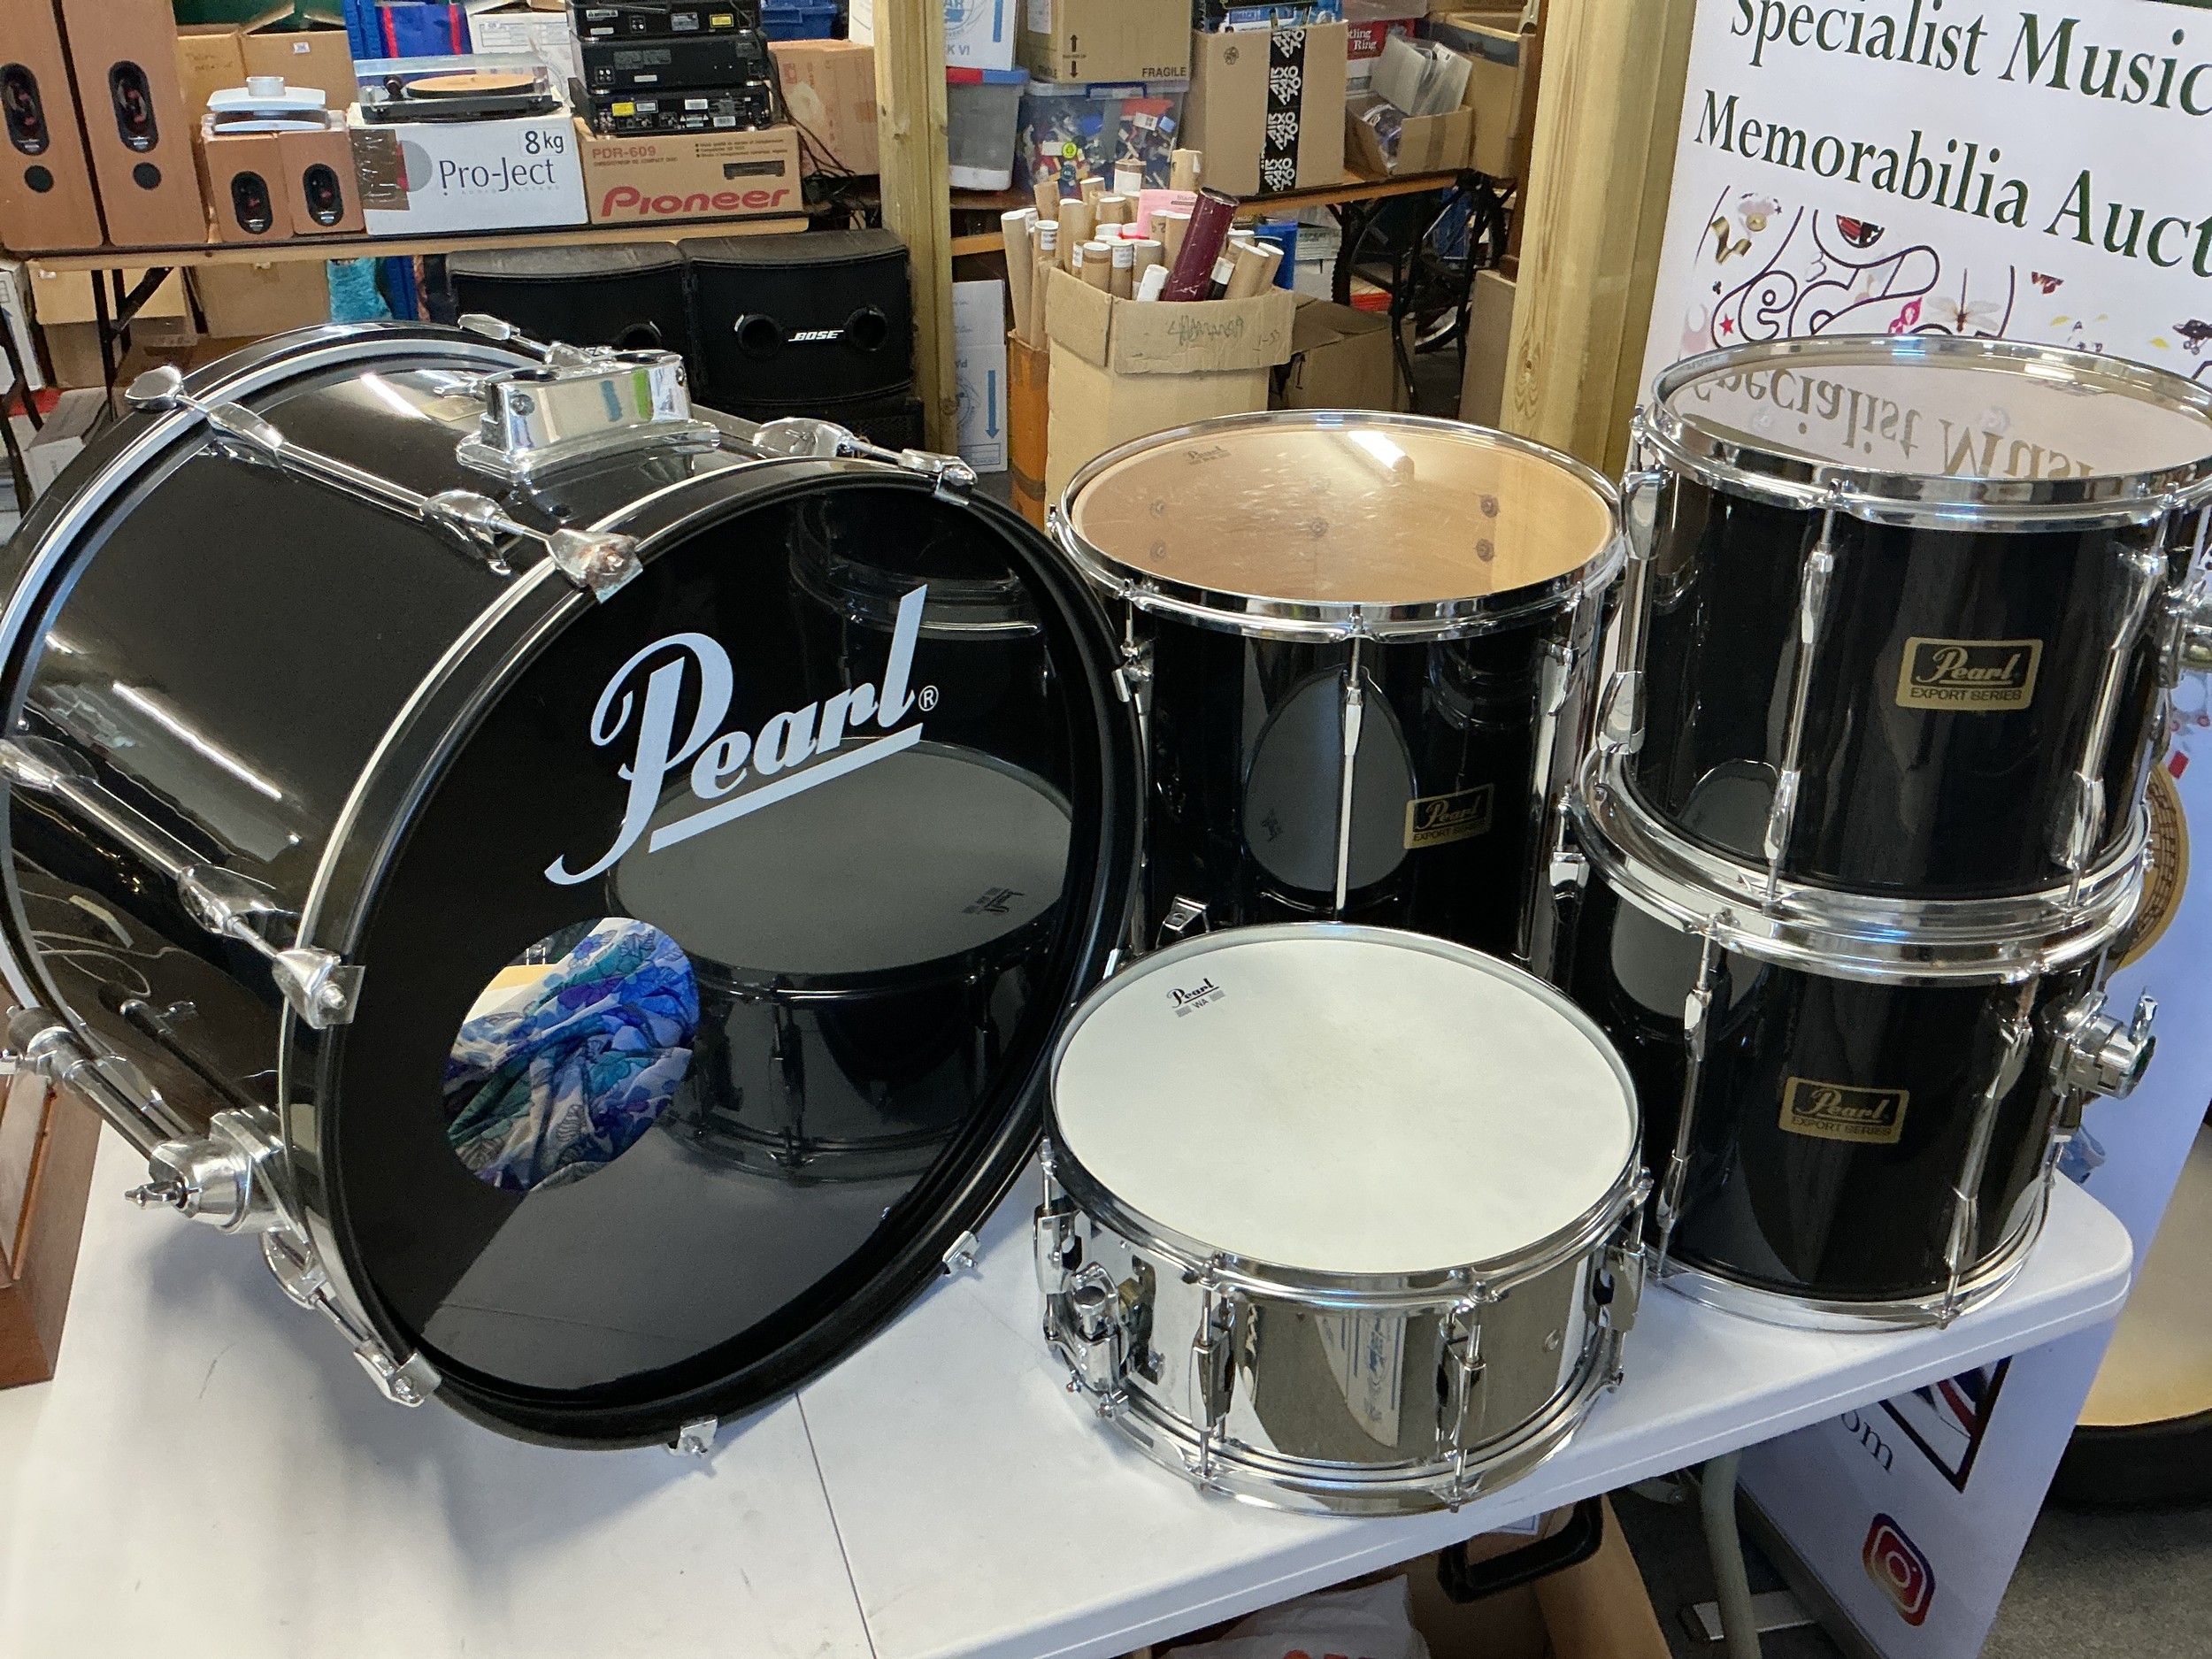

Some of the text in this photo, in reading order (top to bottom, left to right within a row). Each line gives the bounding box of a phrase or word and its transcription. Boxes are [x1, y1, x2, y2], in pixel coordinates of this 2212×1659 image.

[1354, 40, 1377, 51] Ring
[1731, 0, 2212, 116] Specialist Music
[1142, 66, 1187, 78] FRAGILE
[592, 145, 657, 159] PDR-609
[439, 157, 557, 194] Pro-Ject
[1694, 88, 2212, 277] Memorabilia Auct
[601, 186, 790, 217] Pioneer
[793, 330, 841, 341] BOSE
[1916, 647, 2021, 683] Pearl
[1910, 687, 2022, 701] EXPORT SERIES
[544, 584, 928, 885] Pearl
[1415, 795, 1481, 830] Pearl
[1166, 978, 1214, 1008] Pearl
[1192, 998, 1210, 1009] WA
[1795, 1087, 1890, 1119] Pearl
[1792, 1117, 1891, 1136] EXPORT SERIES
